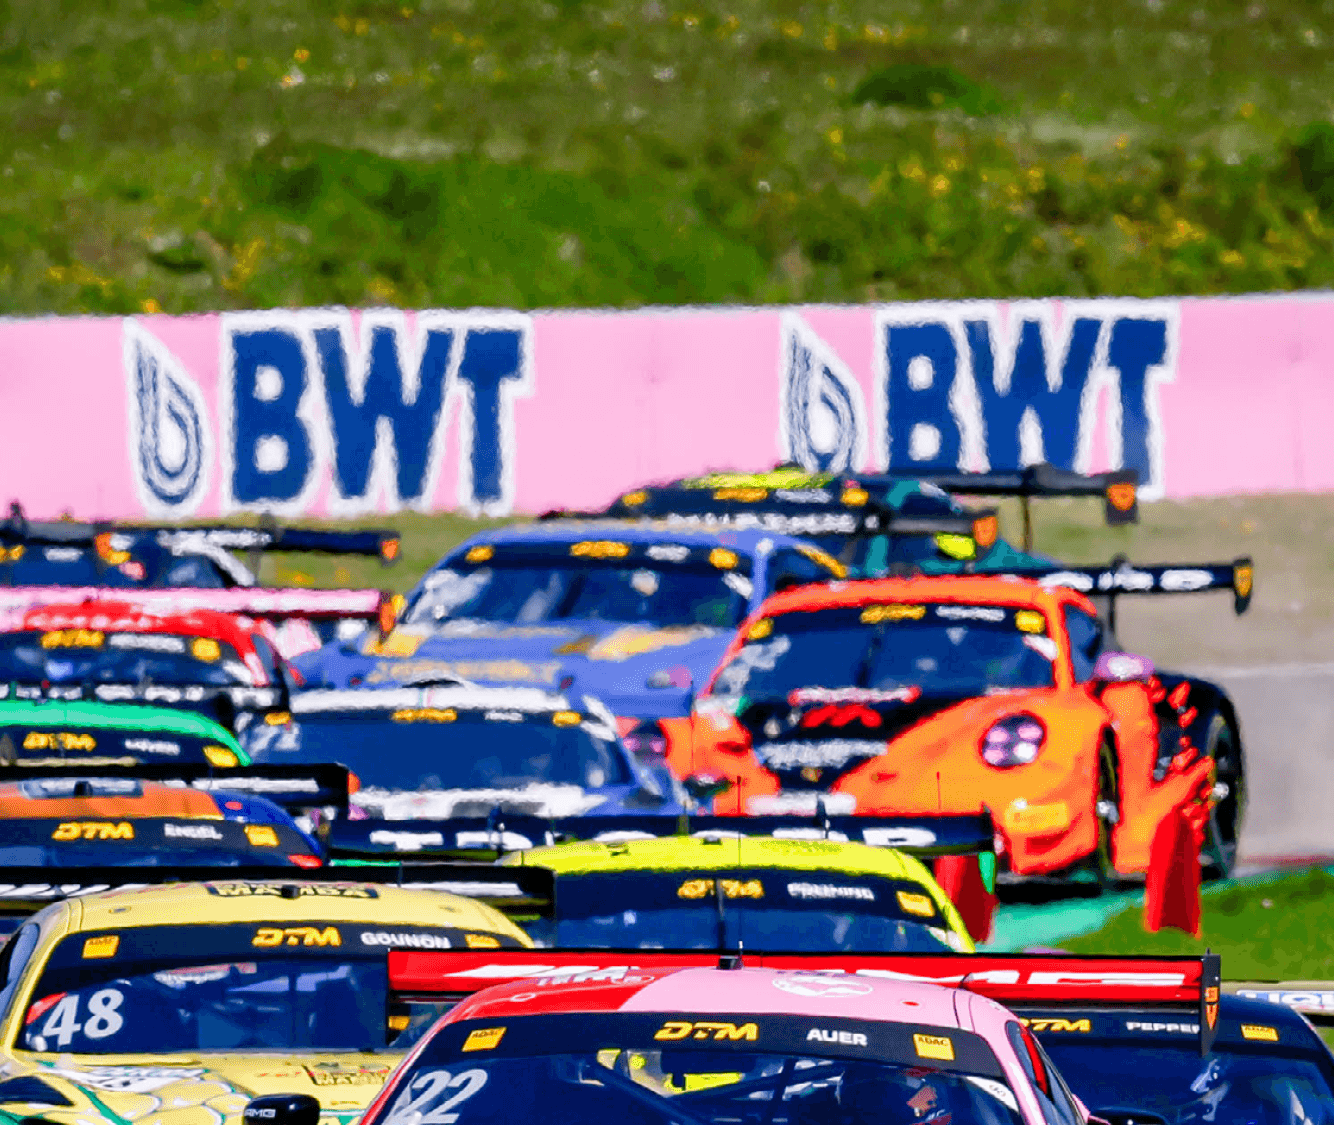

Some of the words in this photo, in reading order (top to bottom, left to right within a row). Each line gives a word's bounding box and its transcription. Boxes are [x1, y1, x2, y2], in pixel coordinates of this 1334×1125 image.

[231, 326, 525, 502] BWT
[885, 317, 1168, 487] BWT
[22, 732, 97, 752] DTM
[51, 822, 135, 840] DTM
[677, 879, 765, 900] DTM
[251, 926, 342, 947] DTM
[359, 931, 453, 950] GOUNON
[42, 988, 125, 1047] 48
[654, 1021, 760, 1042] DTM
[806, 1028, 869, 1047] AUER
[244, 1108, 277, 1119] AMG
